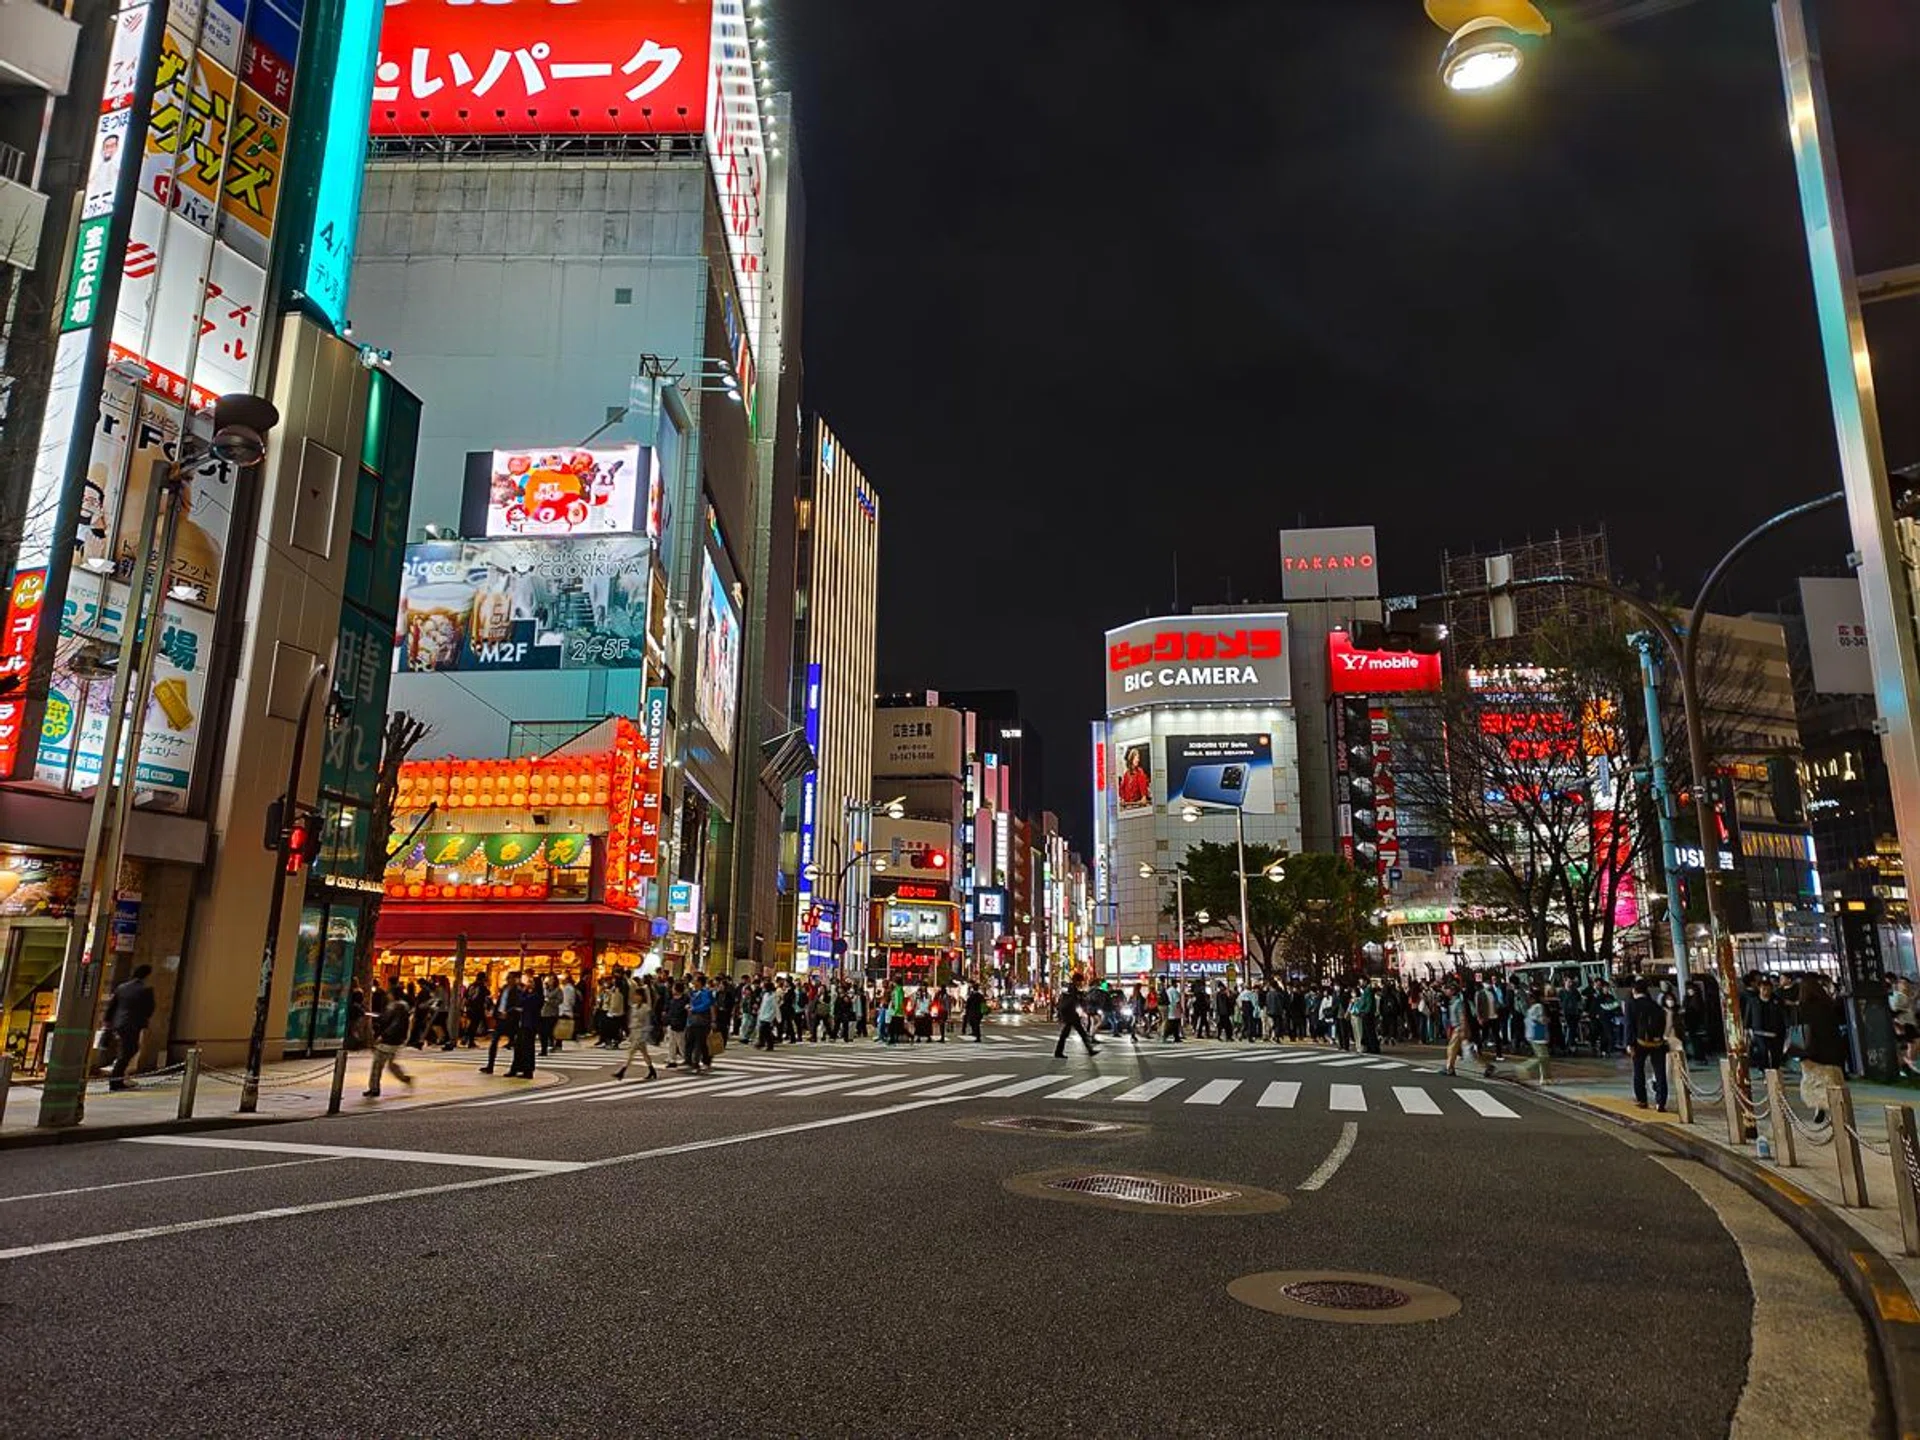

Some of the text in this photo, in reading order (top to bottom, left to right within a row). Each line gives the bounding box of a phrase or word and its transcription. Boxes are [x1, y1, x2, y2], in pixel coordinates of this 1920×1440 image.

[1284, 555, 1373, 570] TAKANO
[480, 642, 528, 663] M2F
[1369, 655, 1419, 669] mobile
[1125, 665, 1259, 693] BIC CAMERA
